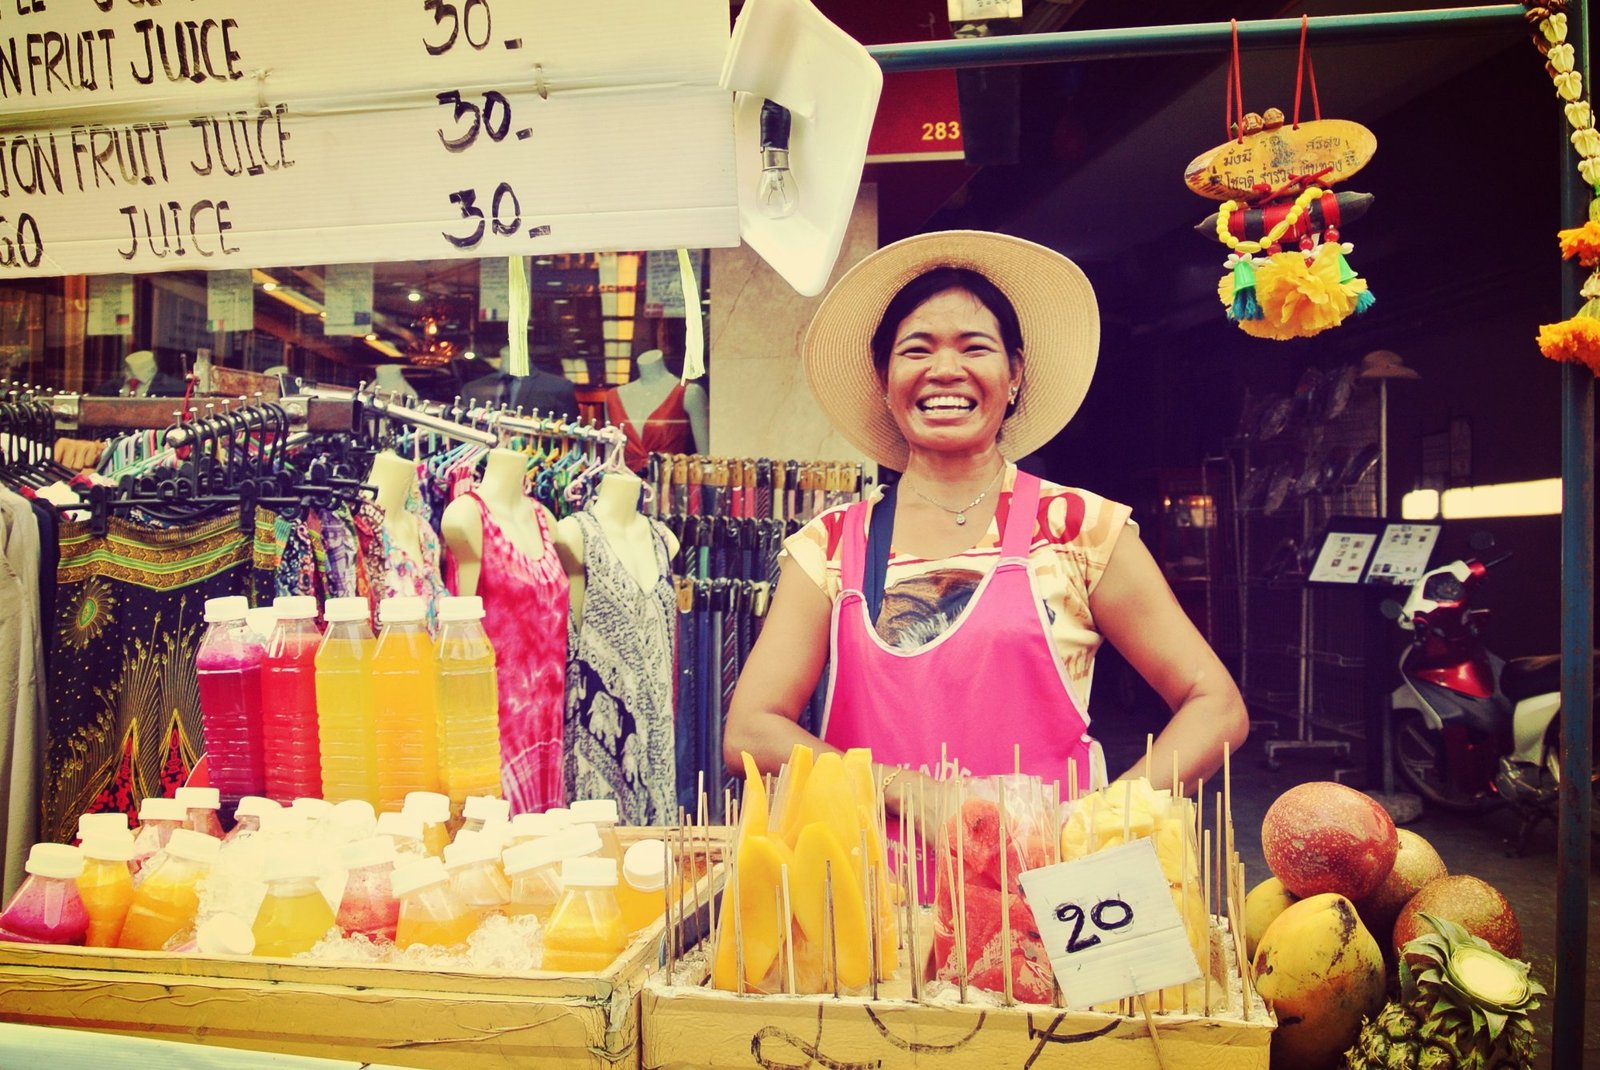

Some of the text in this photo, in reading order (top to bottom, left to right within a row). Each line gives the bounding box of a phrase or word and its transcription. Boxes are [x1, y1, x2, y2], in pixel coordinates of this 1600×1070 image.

[26, 29, 116, 96] FRUIT
[130, 18, 244, 85] JUICE
[71, 121, 170, 192] FRUIT
[189, 103, 296, 178] JUICE
[921, 121, 961, 141] 283
[117, 199, 241, 261] JUICE
[1055, 898, 1134, 954] 20
